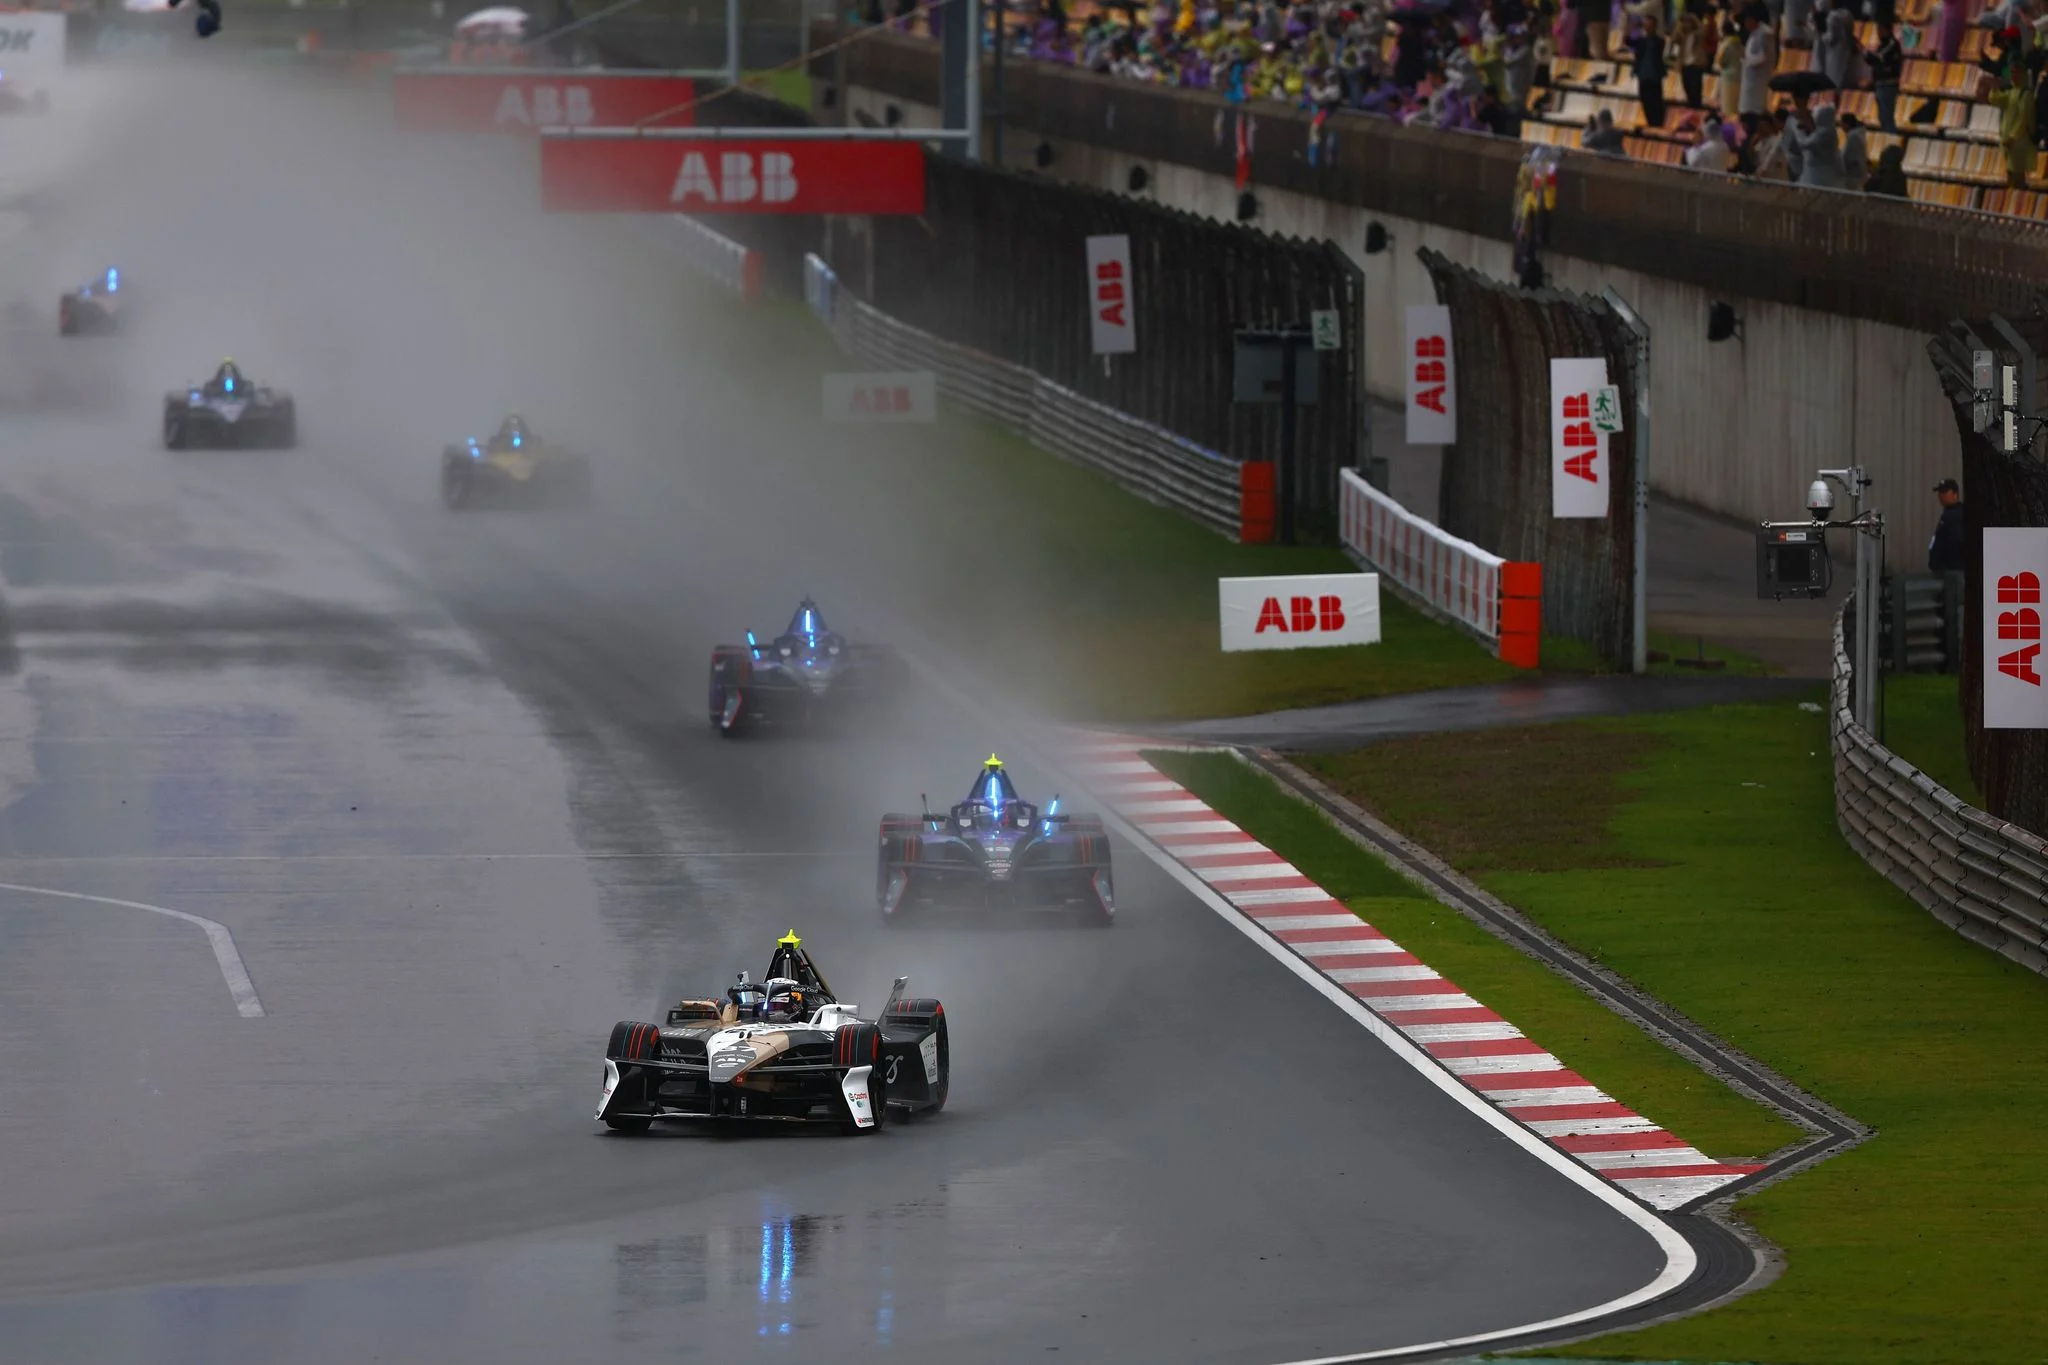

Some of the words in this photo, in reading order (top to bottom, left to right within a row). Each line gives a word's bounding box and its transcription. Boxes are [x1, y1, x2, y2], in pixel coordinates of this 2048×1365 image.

[495, 85, 595, 125] ABB
[671, 152, 798, 203] ABB
[1096, 260, 1125, 327] ABB
[1415, 335, 1446, 414] ABB
[848, 386, 911, 413] ABB
[1255, 595, 1346, 634] ABB
[1997, 571, 2042, 687] ABB
[790, 985, 806, 993] Google
